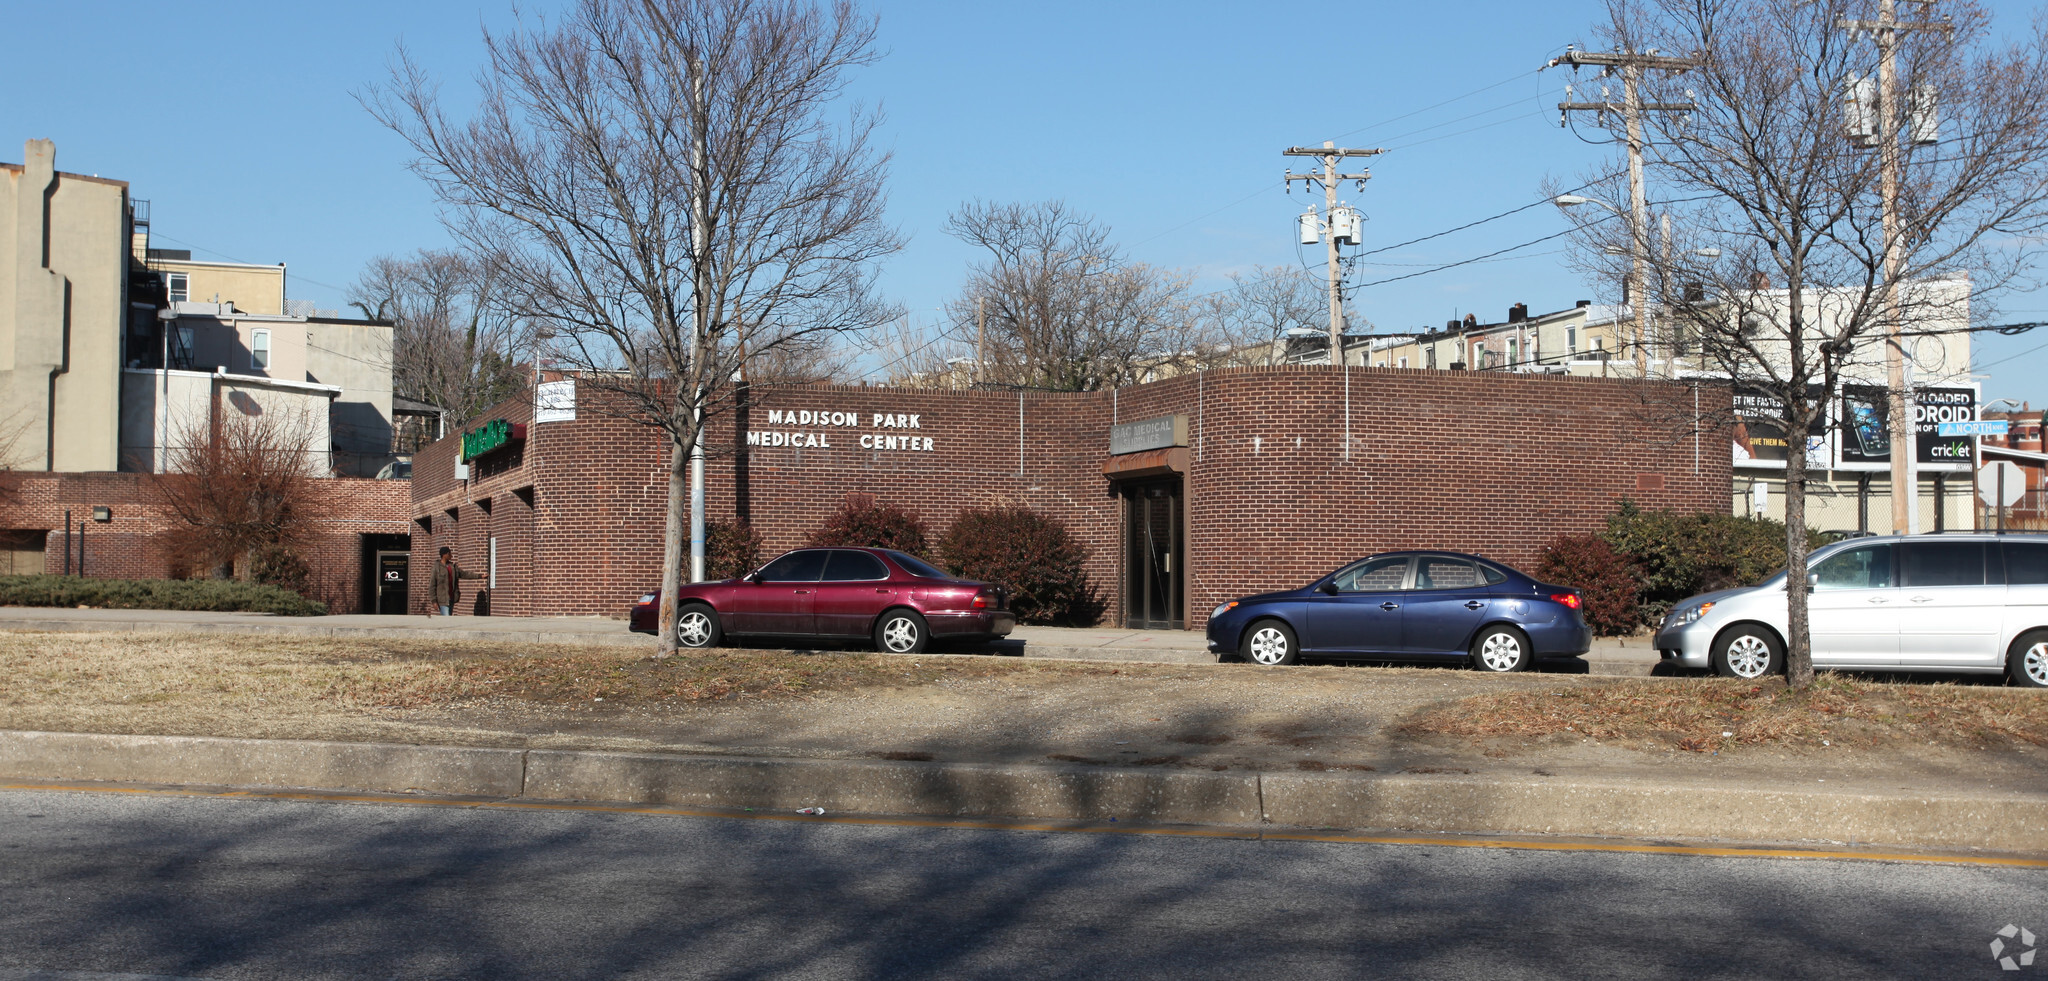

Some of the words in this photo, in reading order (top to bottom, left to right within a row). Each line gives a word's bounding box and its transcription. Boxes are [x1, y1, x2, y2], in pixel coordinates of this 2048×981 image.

[1733, 396, 1742, 406] ET
[1743, 396, 1756, 406] THE
[768, 410, 858, 427] MADISON
[873, 413, 921, 429] PARK
[1134, 420, 1171, 437] MEDICAL
[1922, 424, 1933, 433] OF
[1956, 422, 1993, 434] NORTH
[746, 431, 830, 448] MEDICAL
[859, 434, 934, 451] CENTER
[1750, 437, 1762, 446] GIVE
[1763, 438, 1777, 446] THEM
[1931, 441, 1970, 457] cricket
